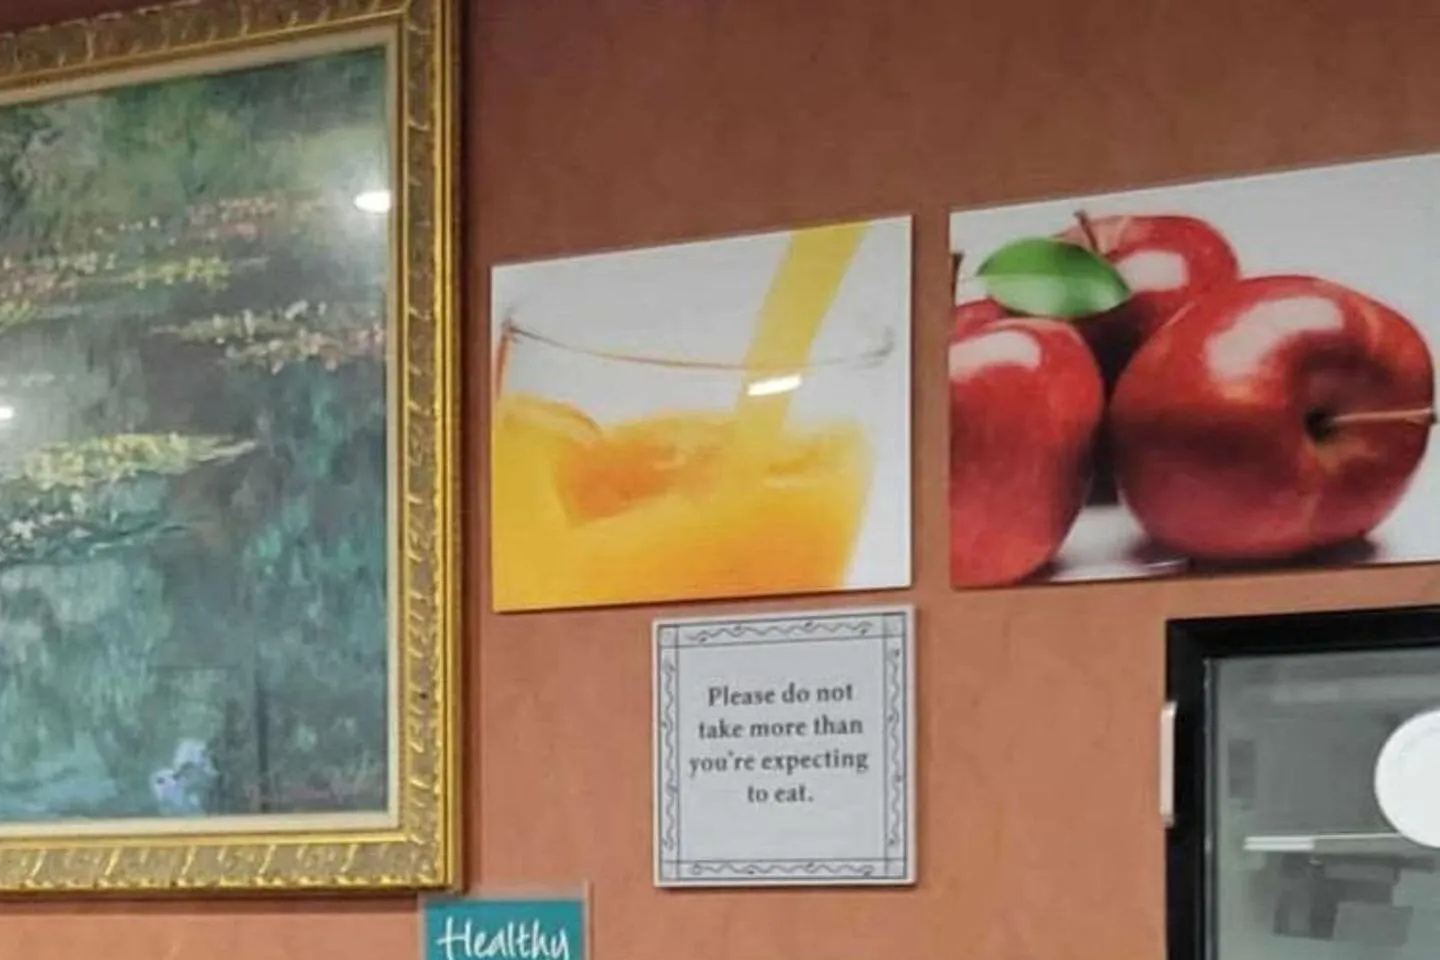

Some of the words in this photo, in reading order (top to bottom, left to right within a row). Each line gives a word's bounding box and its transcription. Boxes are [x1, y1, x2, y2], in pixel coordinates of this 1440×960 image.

[708, 685, 776, 707] Please
[781, 682, 810, 704] do
[816, 683, 853, 703] not
[698, 718, 744, 740] take
[749, 721, 807, 738] more
[813, 714, 864, 736] than
[689, 751, 755, 779] you're
[760, 748, 869, 776] expecting
[746, 785, 768, 803] to
[774, 784, 814, 803] eat.
